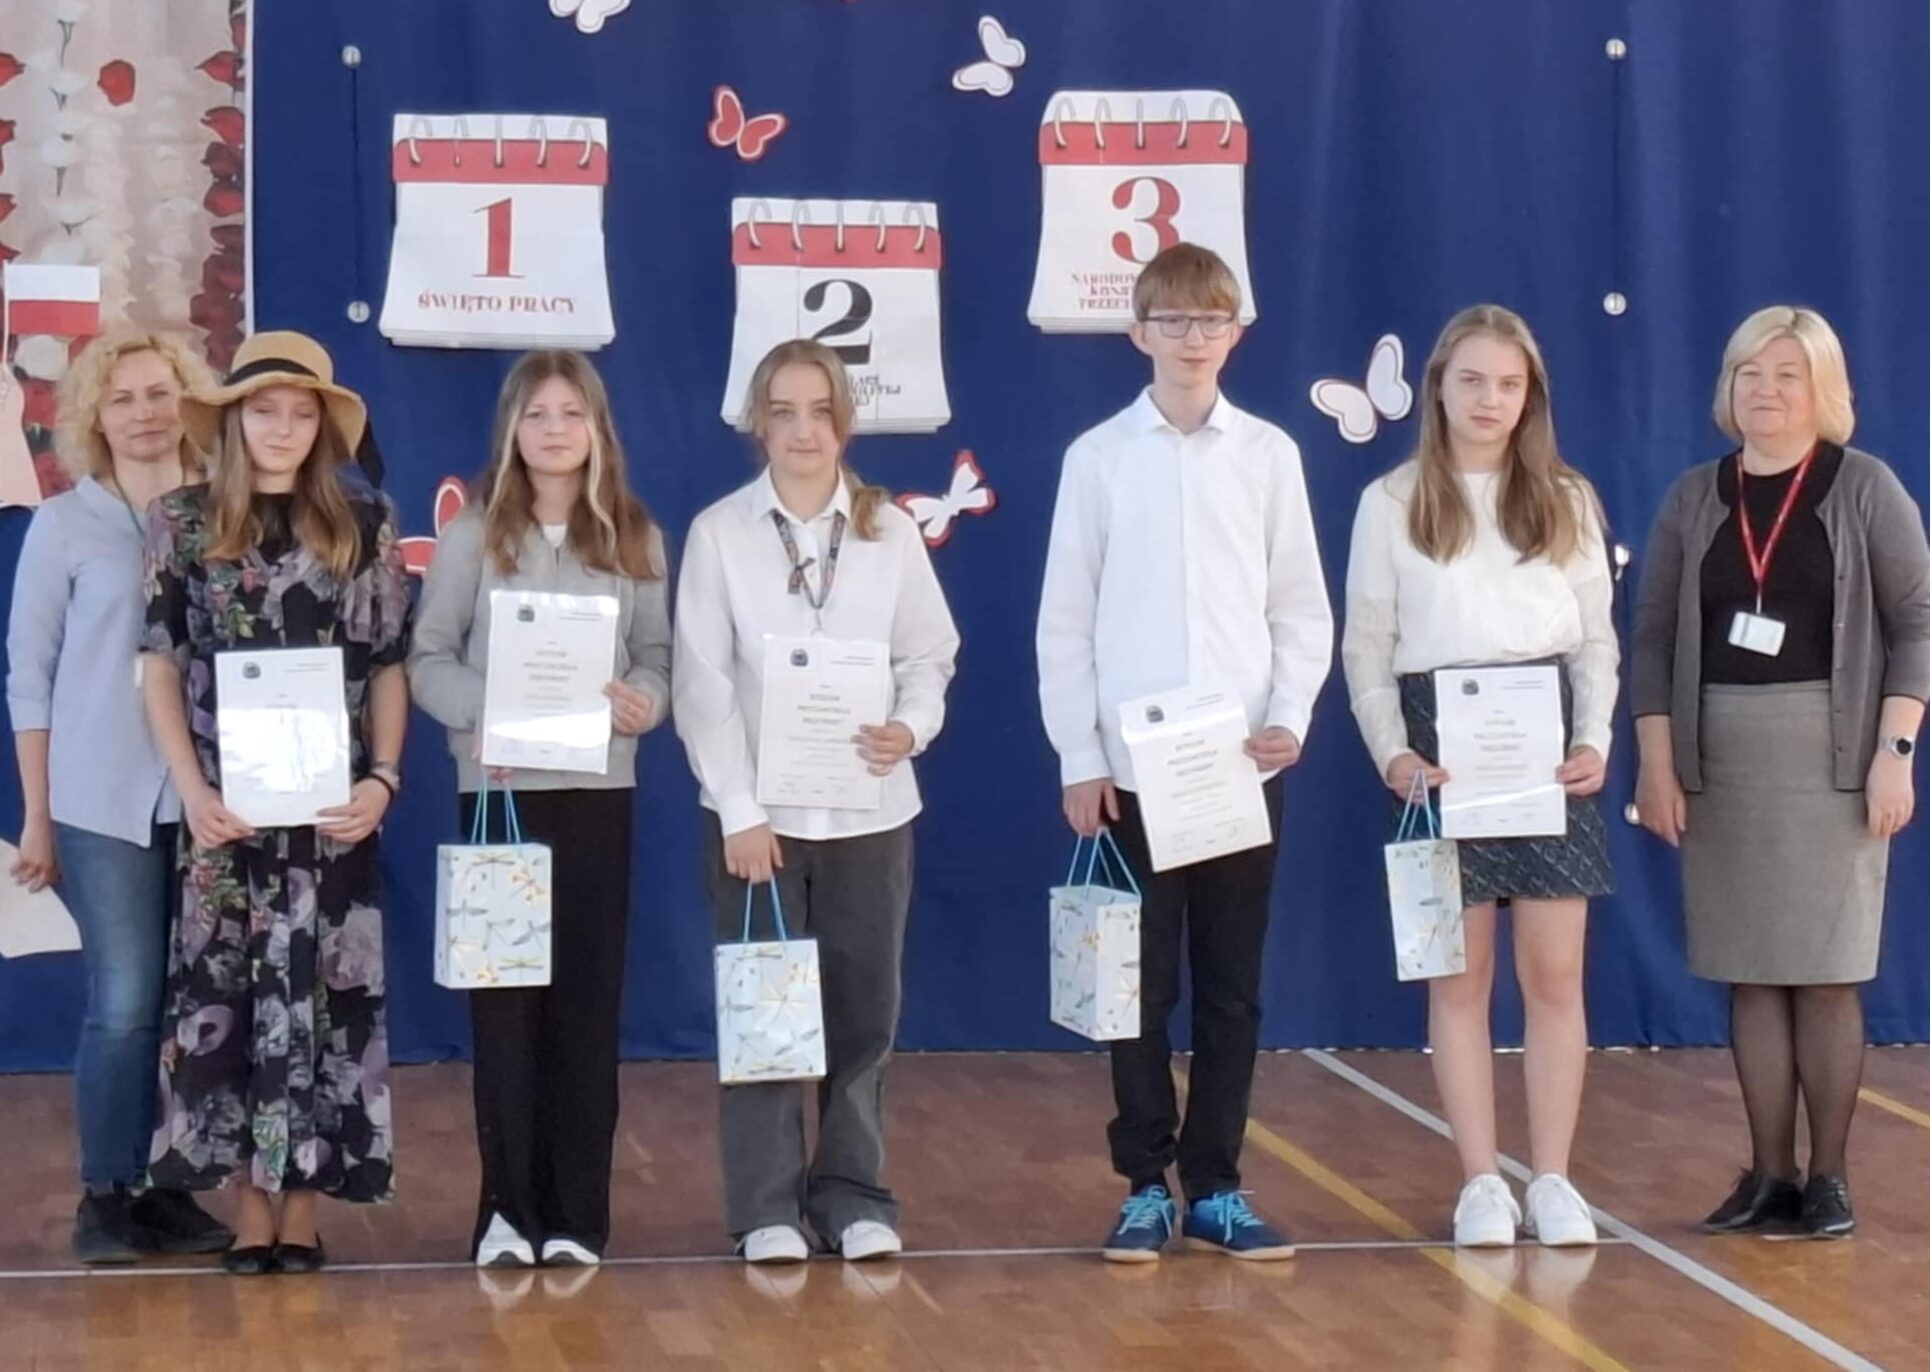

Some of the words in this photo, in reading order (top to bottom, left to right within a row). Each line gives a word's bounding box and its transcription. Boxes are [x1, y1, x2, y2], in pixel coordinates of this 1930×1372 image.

[473, 197, 525, 278] 1
[1111, 176, 1181, 265] 3
[417, 290, 502, 314] ŚWIĘTO
[510, 295, 577, 314] PRACY
[803, 278, 873, 365] 2
